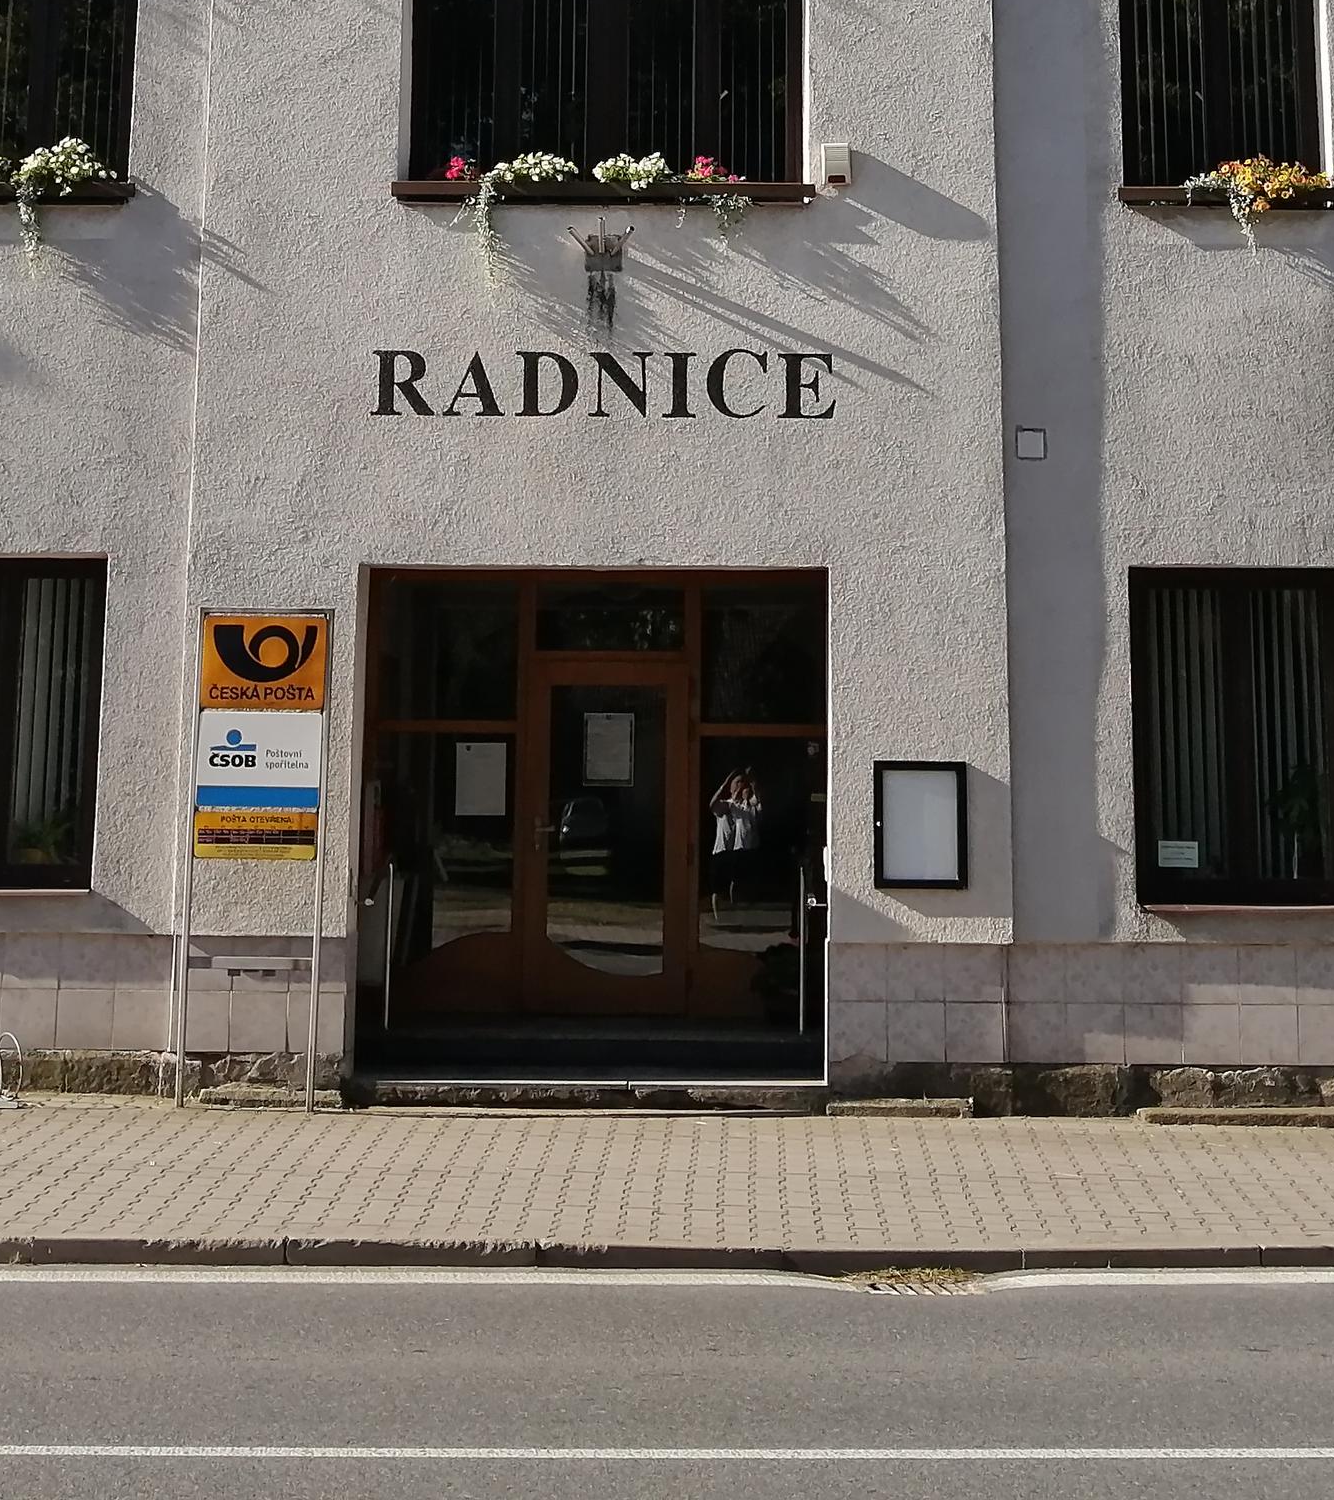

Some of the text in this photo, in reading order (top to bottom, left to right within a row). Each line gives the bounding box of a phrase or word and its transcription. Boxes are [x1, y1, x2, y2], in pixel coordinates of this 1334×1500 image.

[369, 348, 837, 420] RADNICE
[208, 684, 316, 701] ČESKÁ POŠTA
[208, 752, 257, 768] ČSOB
[265, 749, 302, 758] Poštovní
[265, 761, 309, 770] spořitelna
